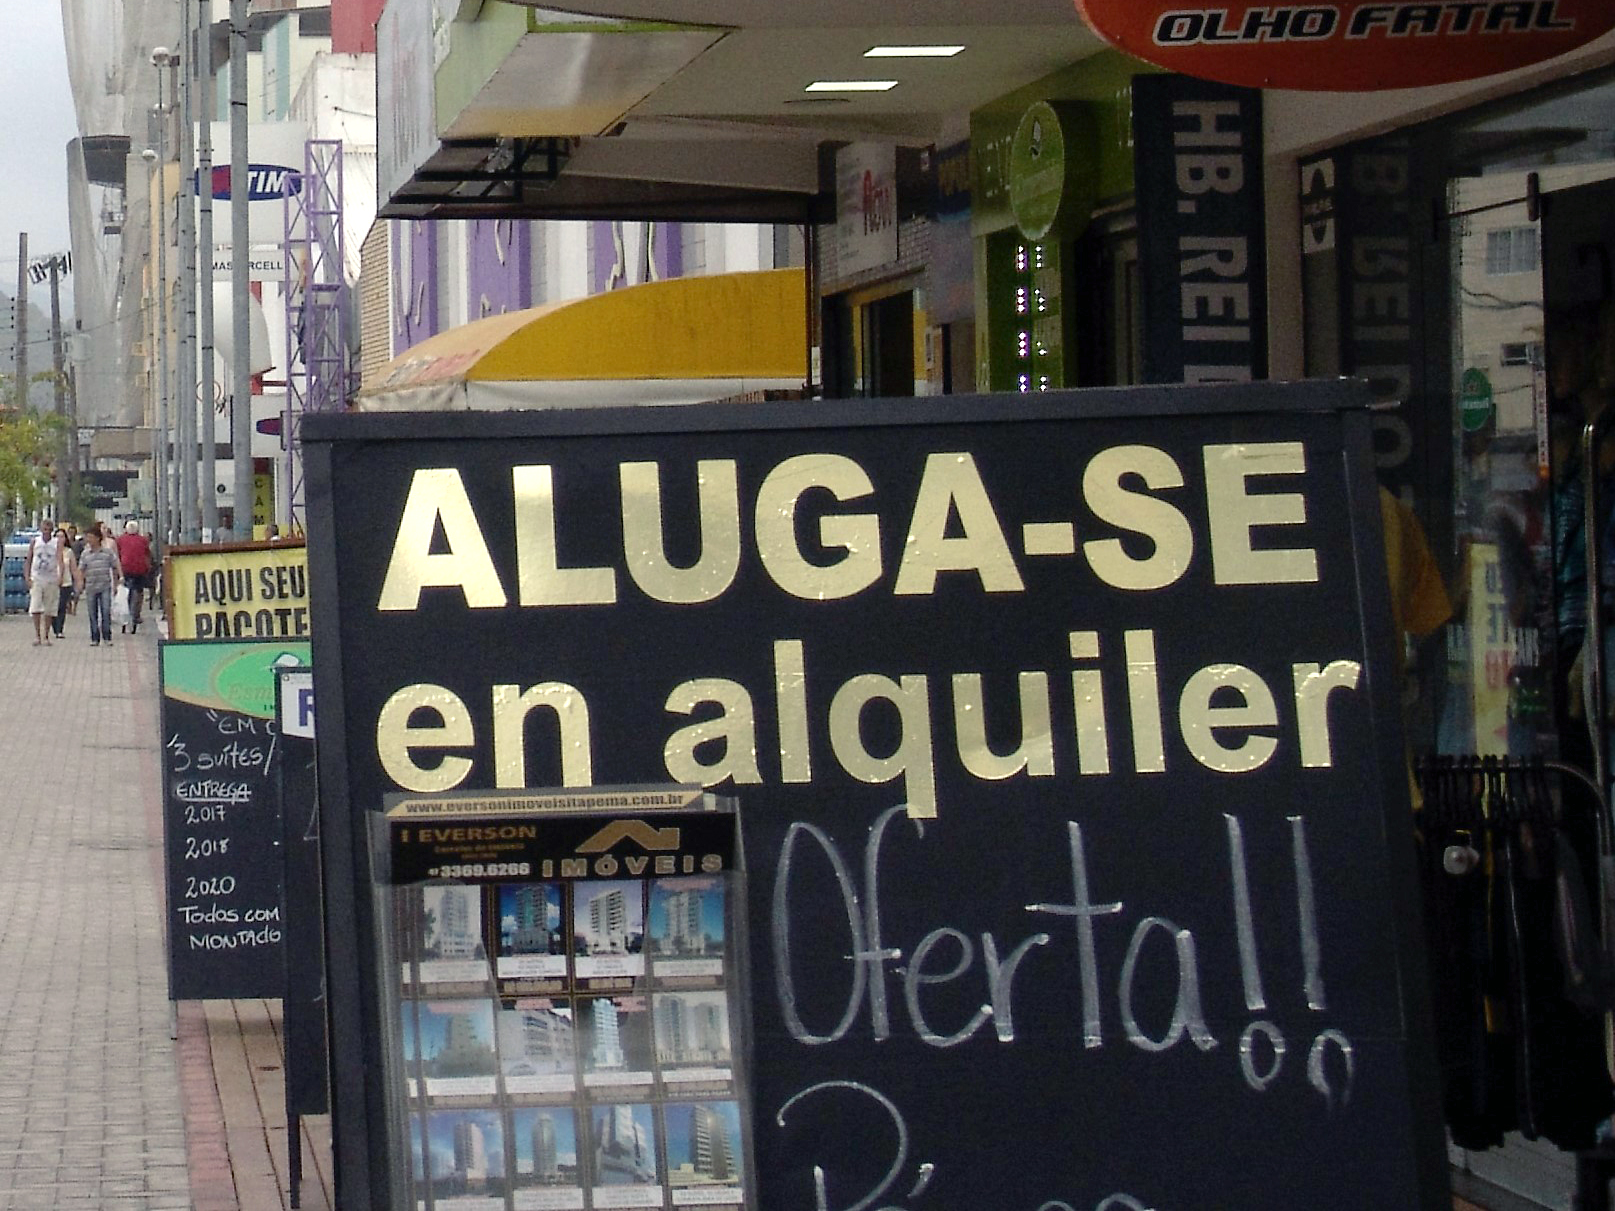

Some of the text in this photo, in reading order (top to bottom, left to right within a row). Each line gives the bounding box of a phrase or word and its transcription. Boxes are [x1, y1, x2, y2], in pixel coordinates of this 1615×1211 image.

[1152, 4, 1341, 47] OLHO
[1179, 236, 1250, 341] REI
[377, 441, 1320, 612] ALUGA-SE
[195, 565, 306, 606] AQUI SEU
[376, 629, 1362, 819] en alquiler
[185, 805, 226, 825] 2017
[185, 837, 231, 860] 2018
[418, 825, 538, 843] EVERSON
[541, 853, 723, 879] IMÓVEIS
[185, 876, 236, 899] 2020
